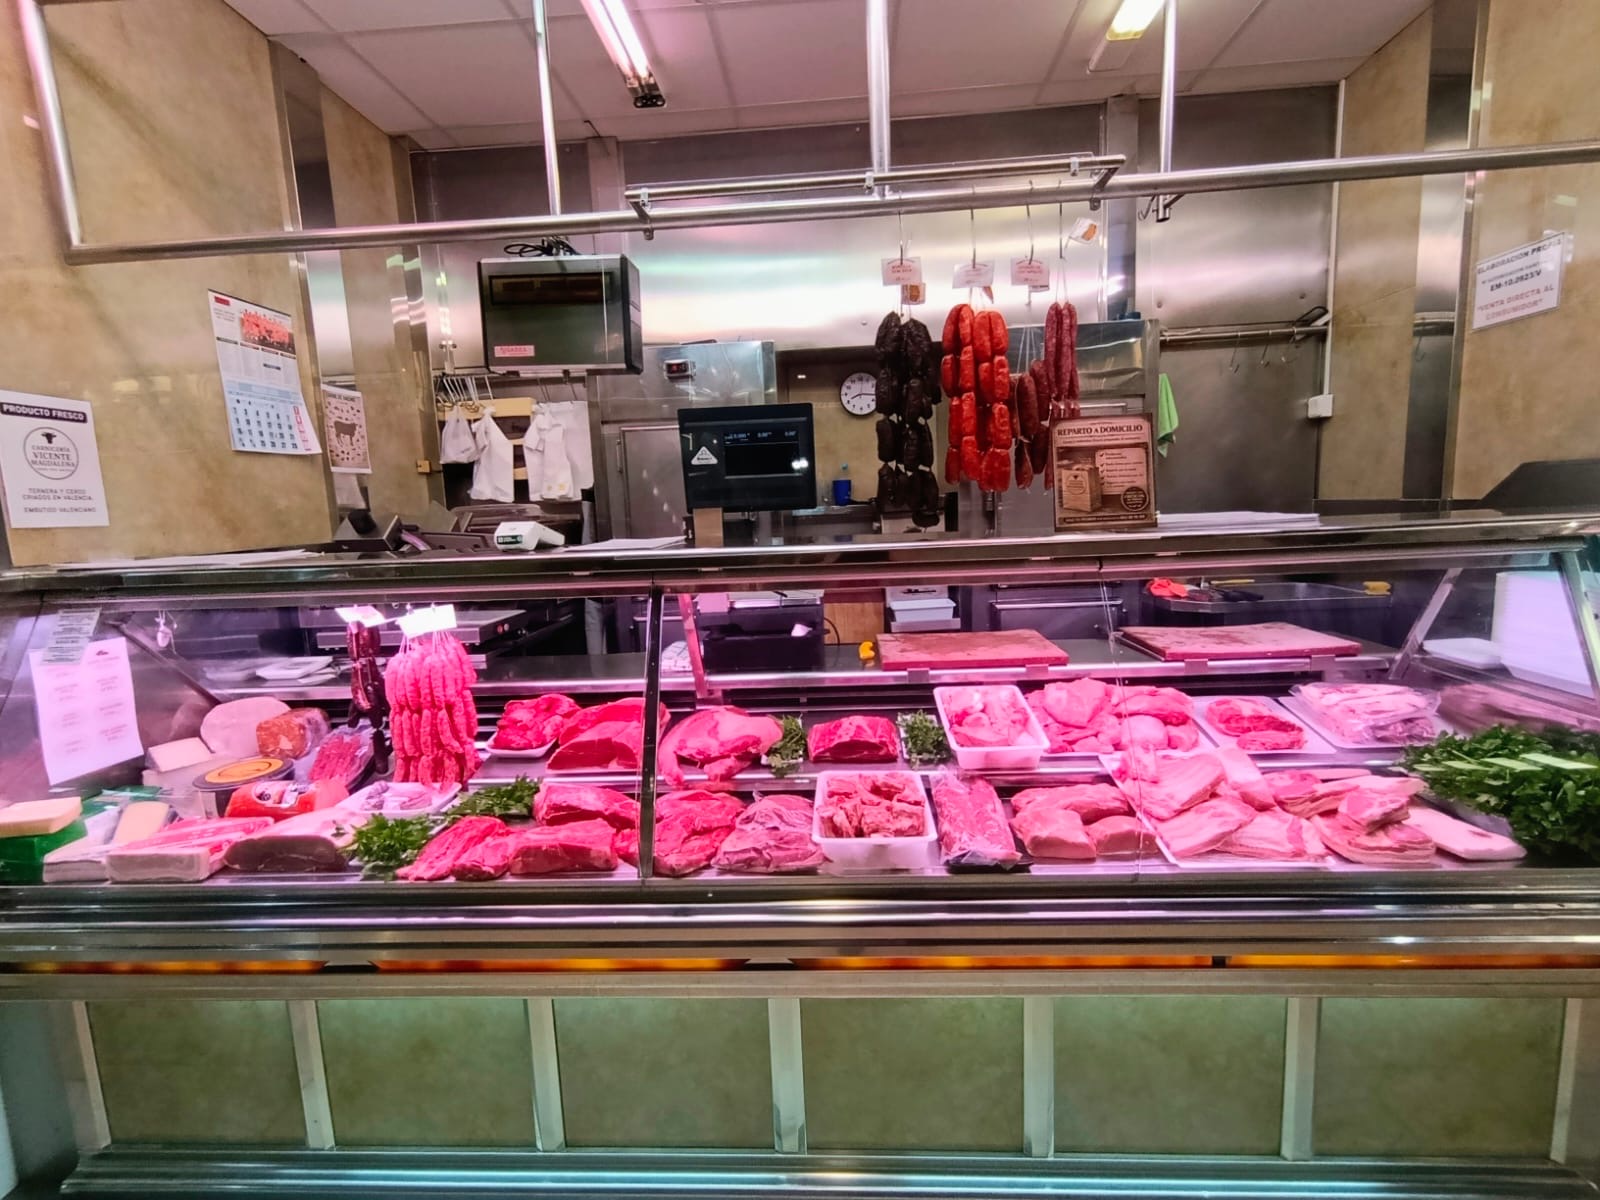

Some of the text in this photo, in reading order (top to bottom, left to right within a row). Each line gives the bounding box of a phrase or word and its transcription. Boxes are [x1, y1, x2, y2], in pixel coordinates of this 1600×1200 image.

[3, 404, 84, 420] PRODUCTO FRESCO
[1058, 427, 1092, 436] REPARTO
[1100, 424, 1143, 433] DOMICILIO
[32, 451, 72, 461] VICENTE
[31, 459, 76, 467] MAGDALENA
